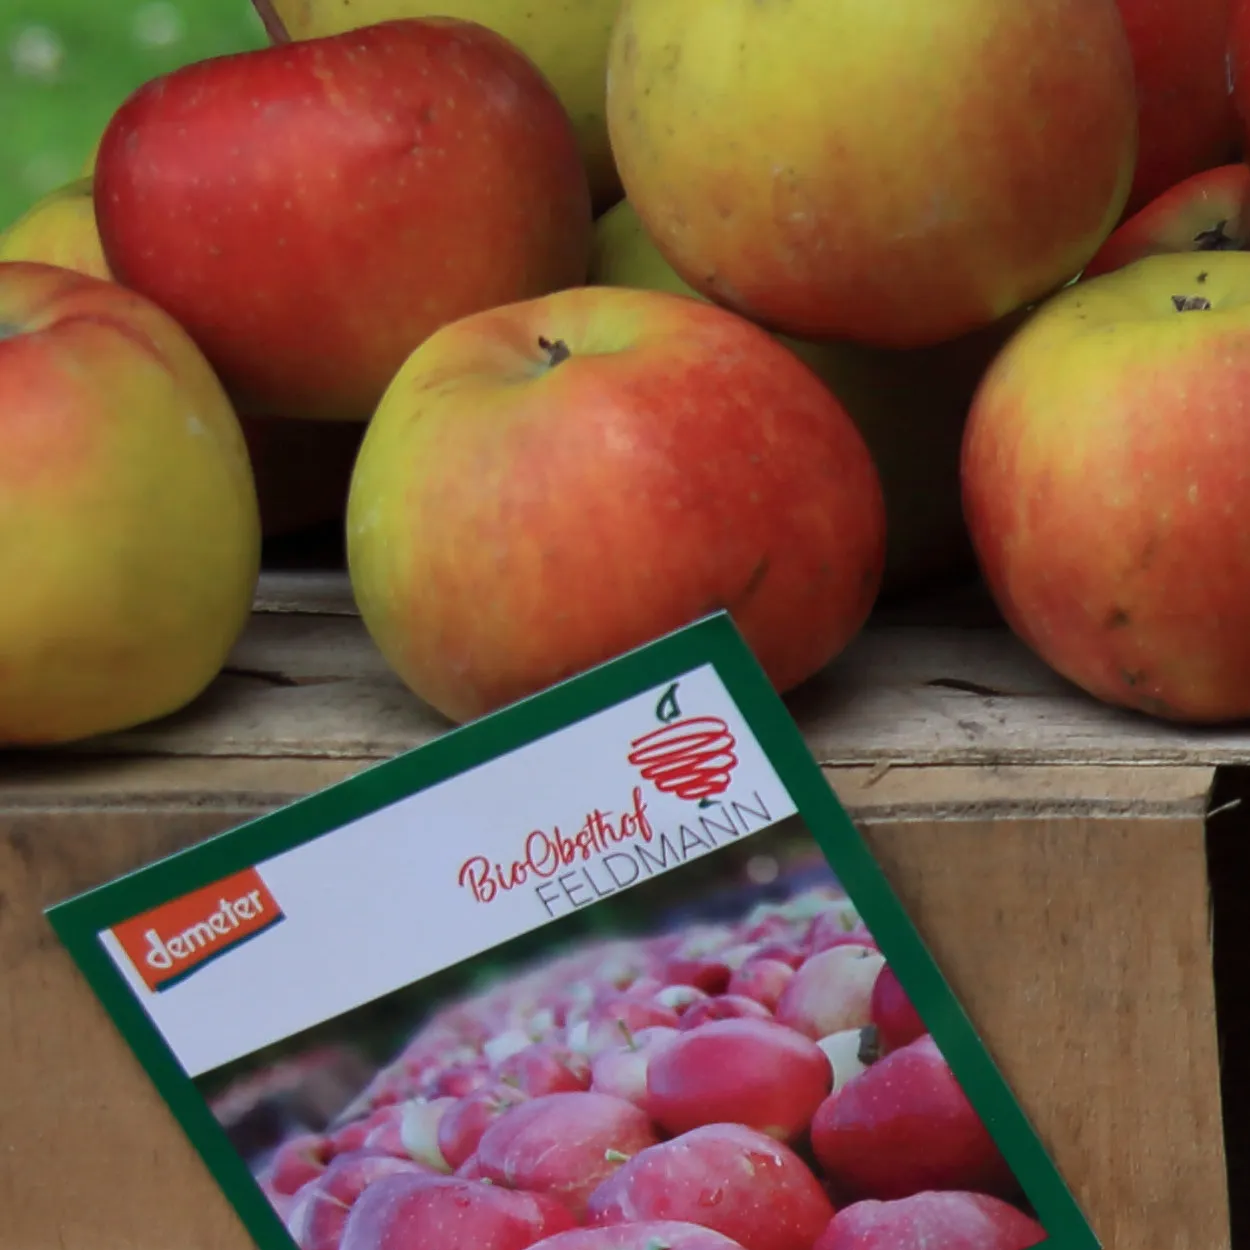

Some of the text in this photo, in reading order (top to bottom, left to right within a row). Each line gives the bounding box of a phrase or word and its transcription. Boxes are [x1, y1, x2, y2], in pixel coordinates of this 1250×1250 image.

[458, 786, 652, 903] BioObsthof
[534, 792, 772, 918] FELDMANN
[143, 888, 264, 970] demeter
